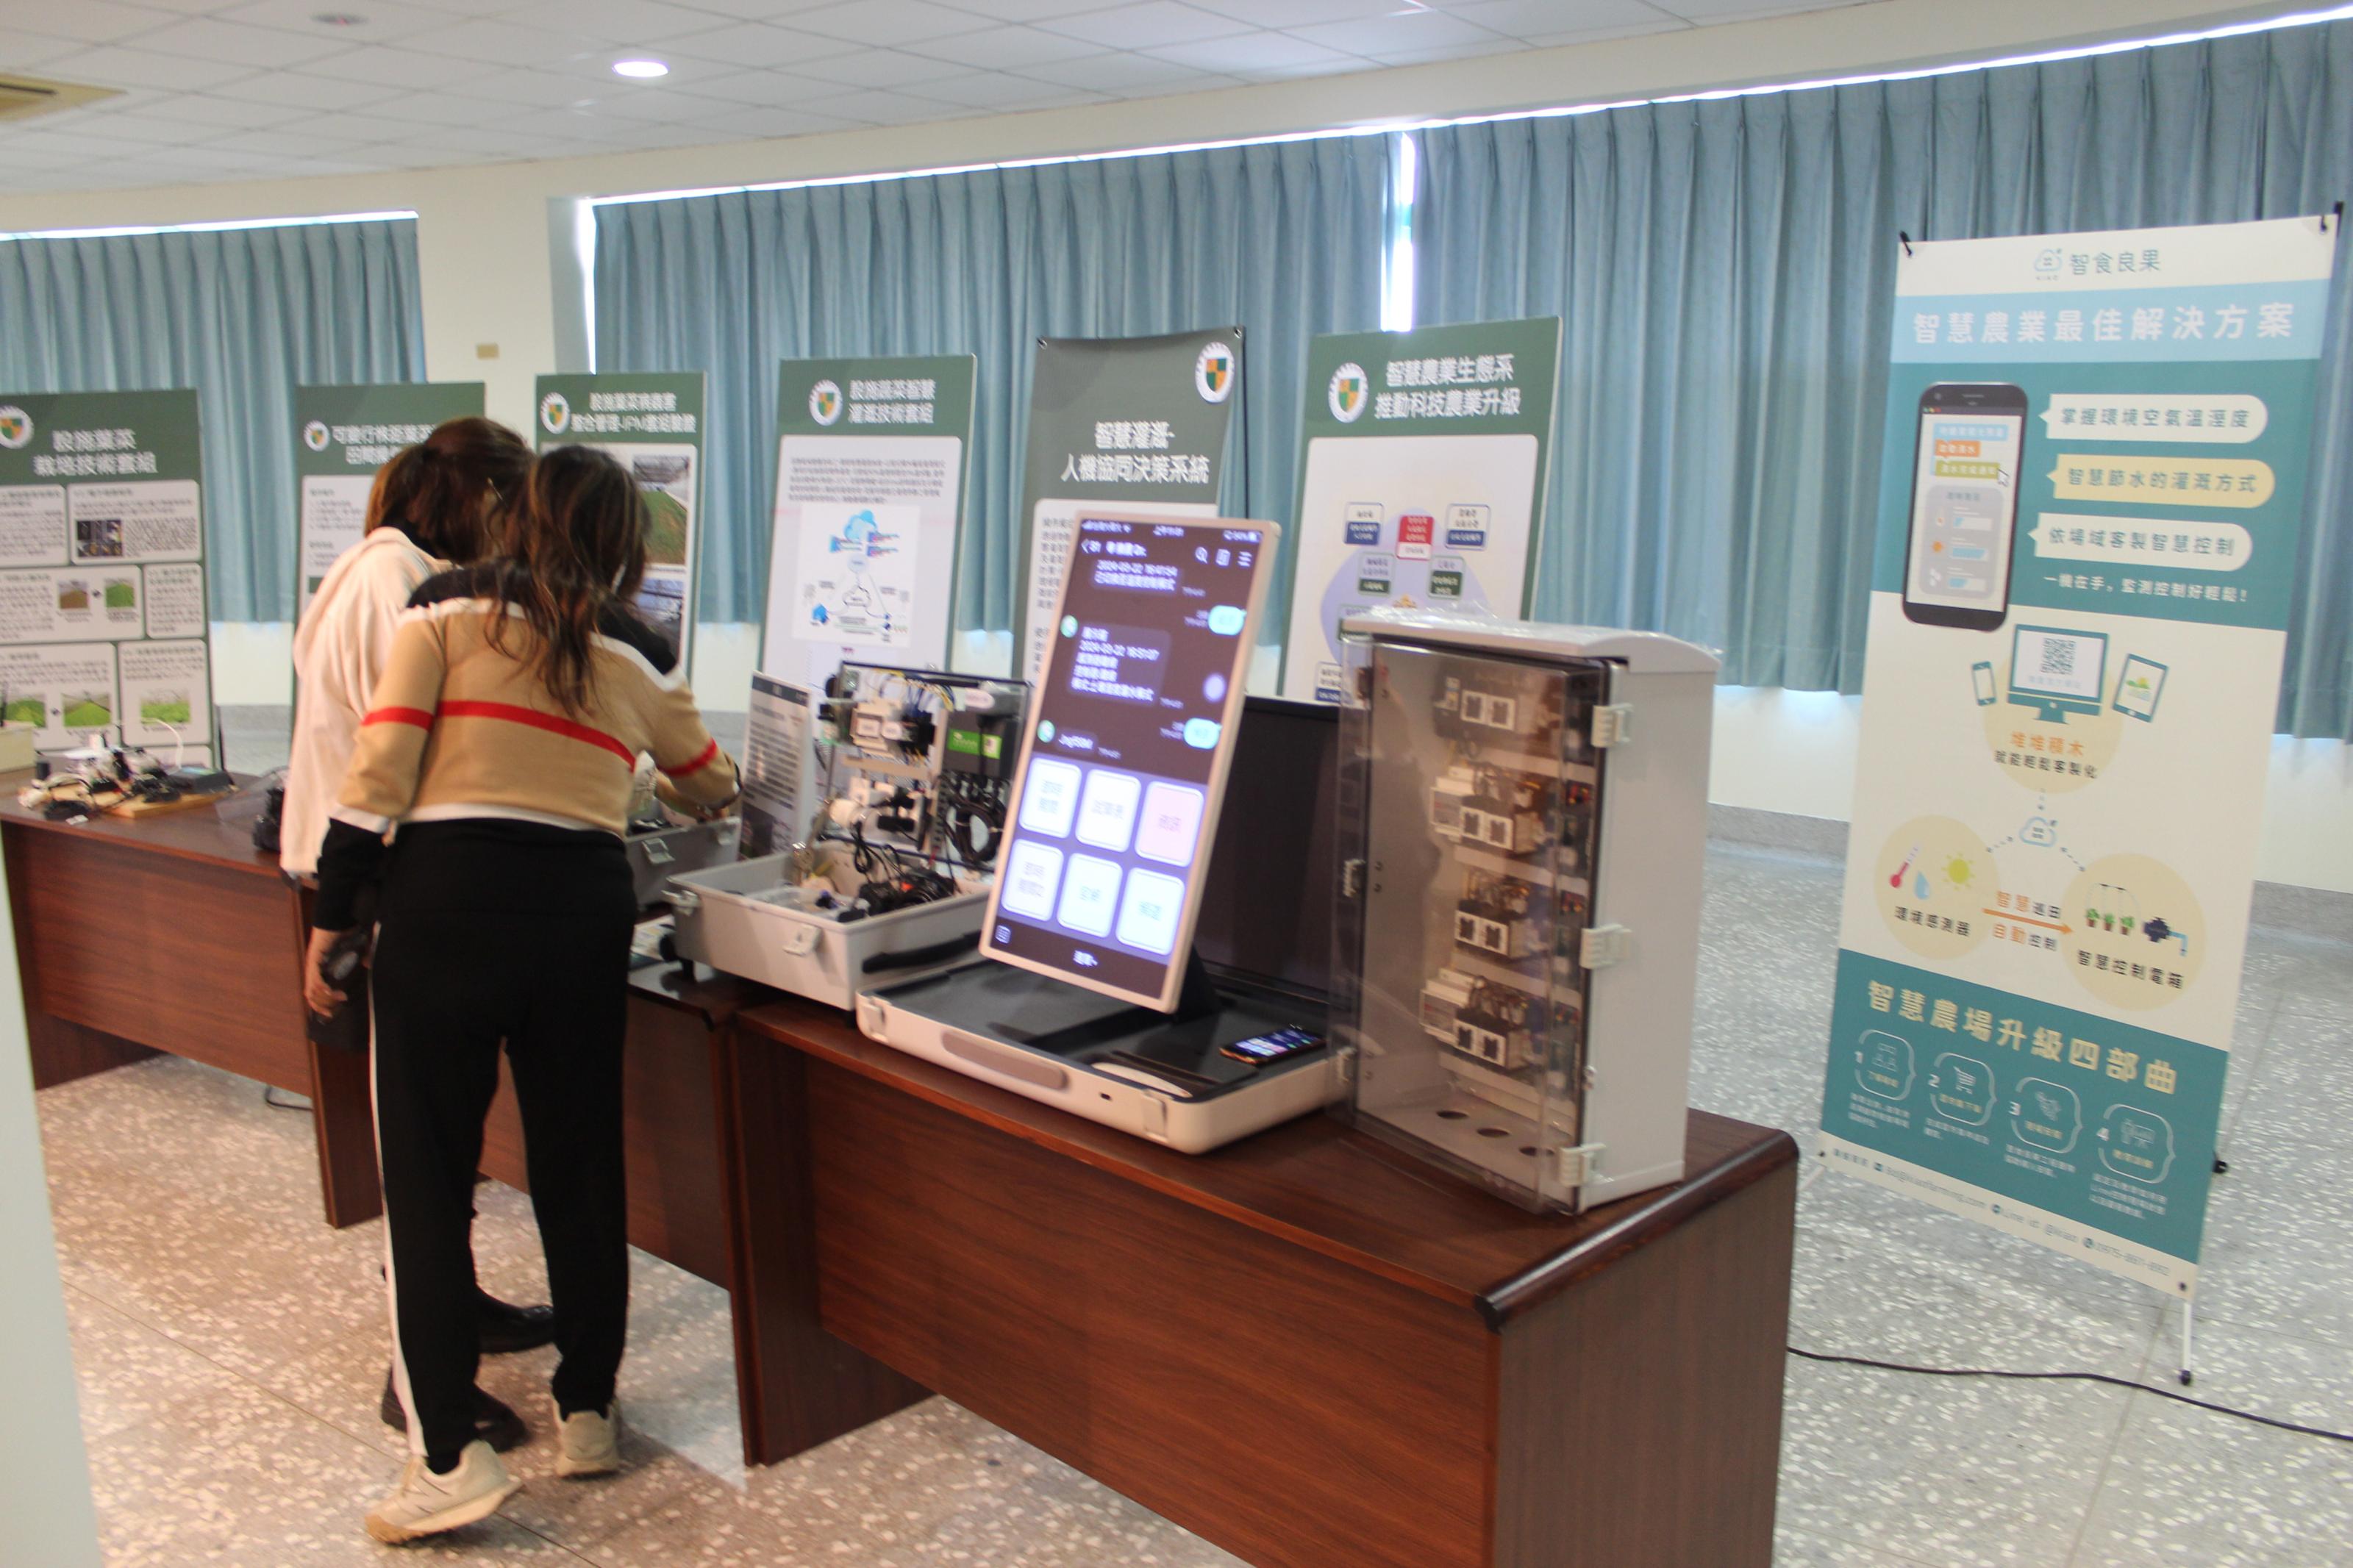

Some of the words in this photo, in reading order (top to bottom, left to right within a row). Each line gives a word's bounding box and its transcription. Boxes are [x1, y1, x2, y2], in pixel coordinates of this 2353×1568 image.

[2070, 248, 2162, 276] 智食良果
[1913, 301, 2296, 346] 智慧農業最佳解決方案
[2068, 468, 2258, 493] 智慧節水的灌溉方式
[1992, 922, 2057, 951] 自動控制
[1866, 979, 2178, 1095] 智慧農場升級四部曲
[1854, 1050, 1864, 1064] 1
[1927, 1073, 1940, 1089] 2
[2008, 1100, 2021, 1117] 3
[2096, 1127, 2110, 1142] 4
